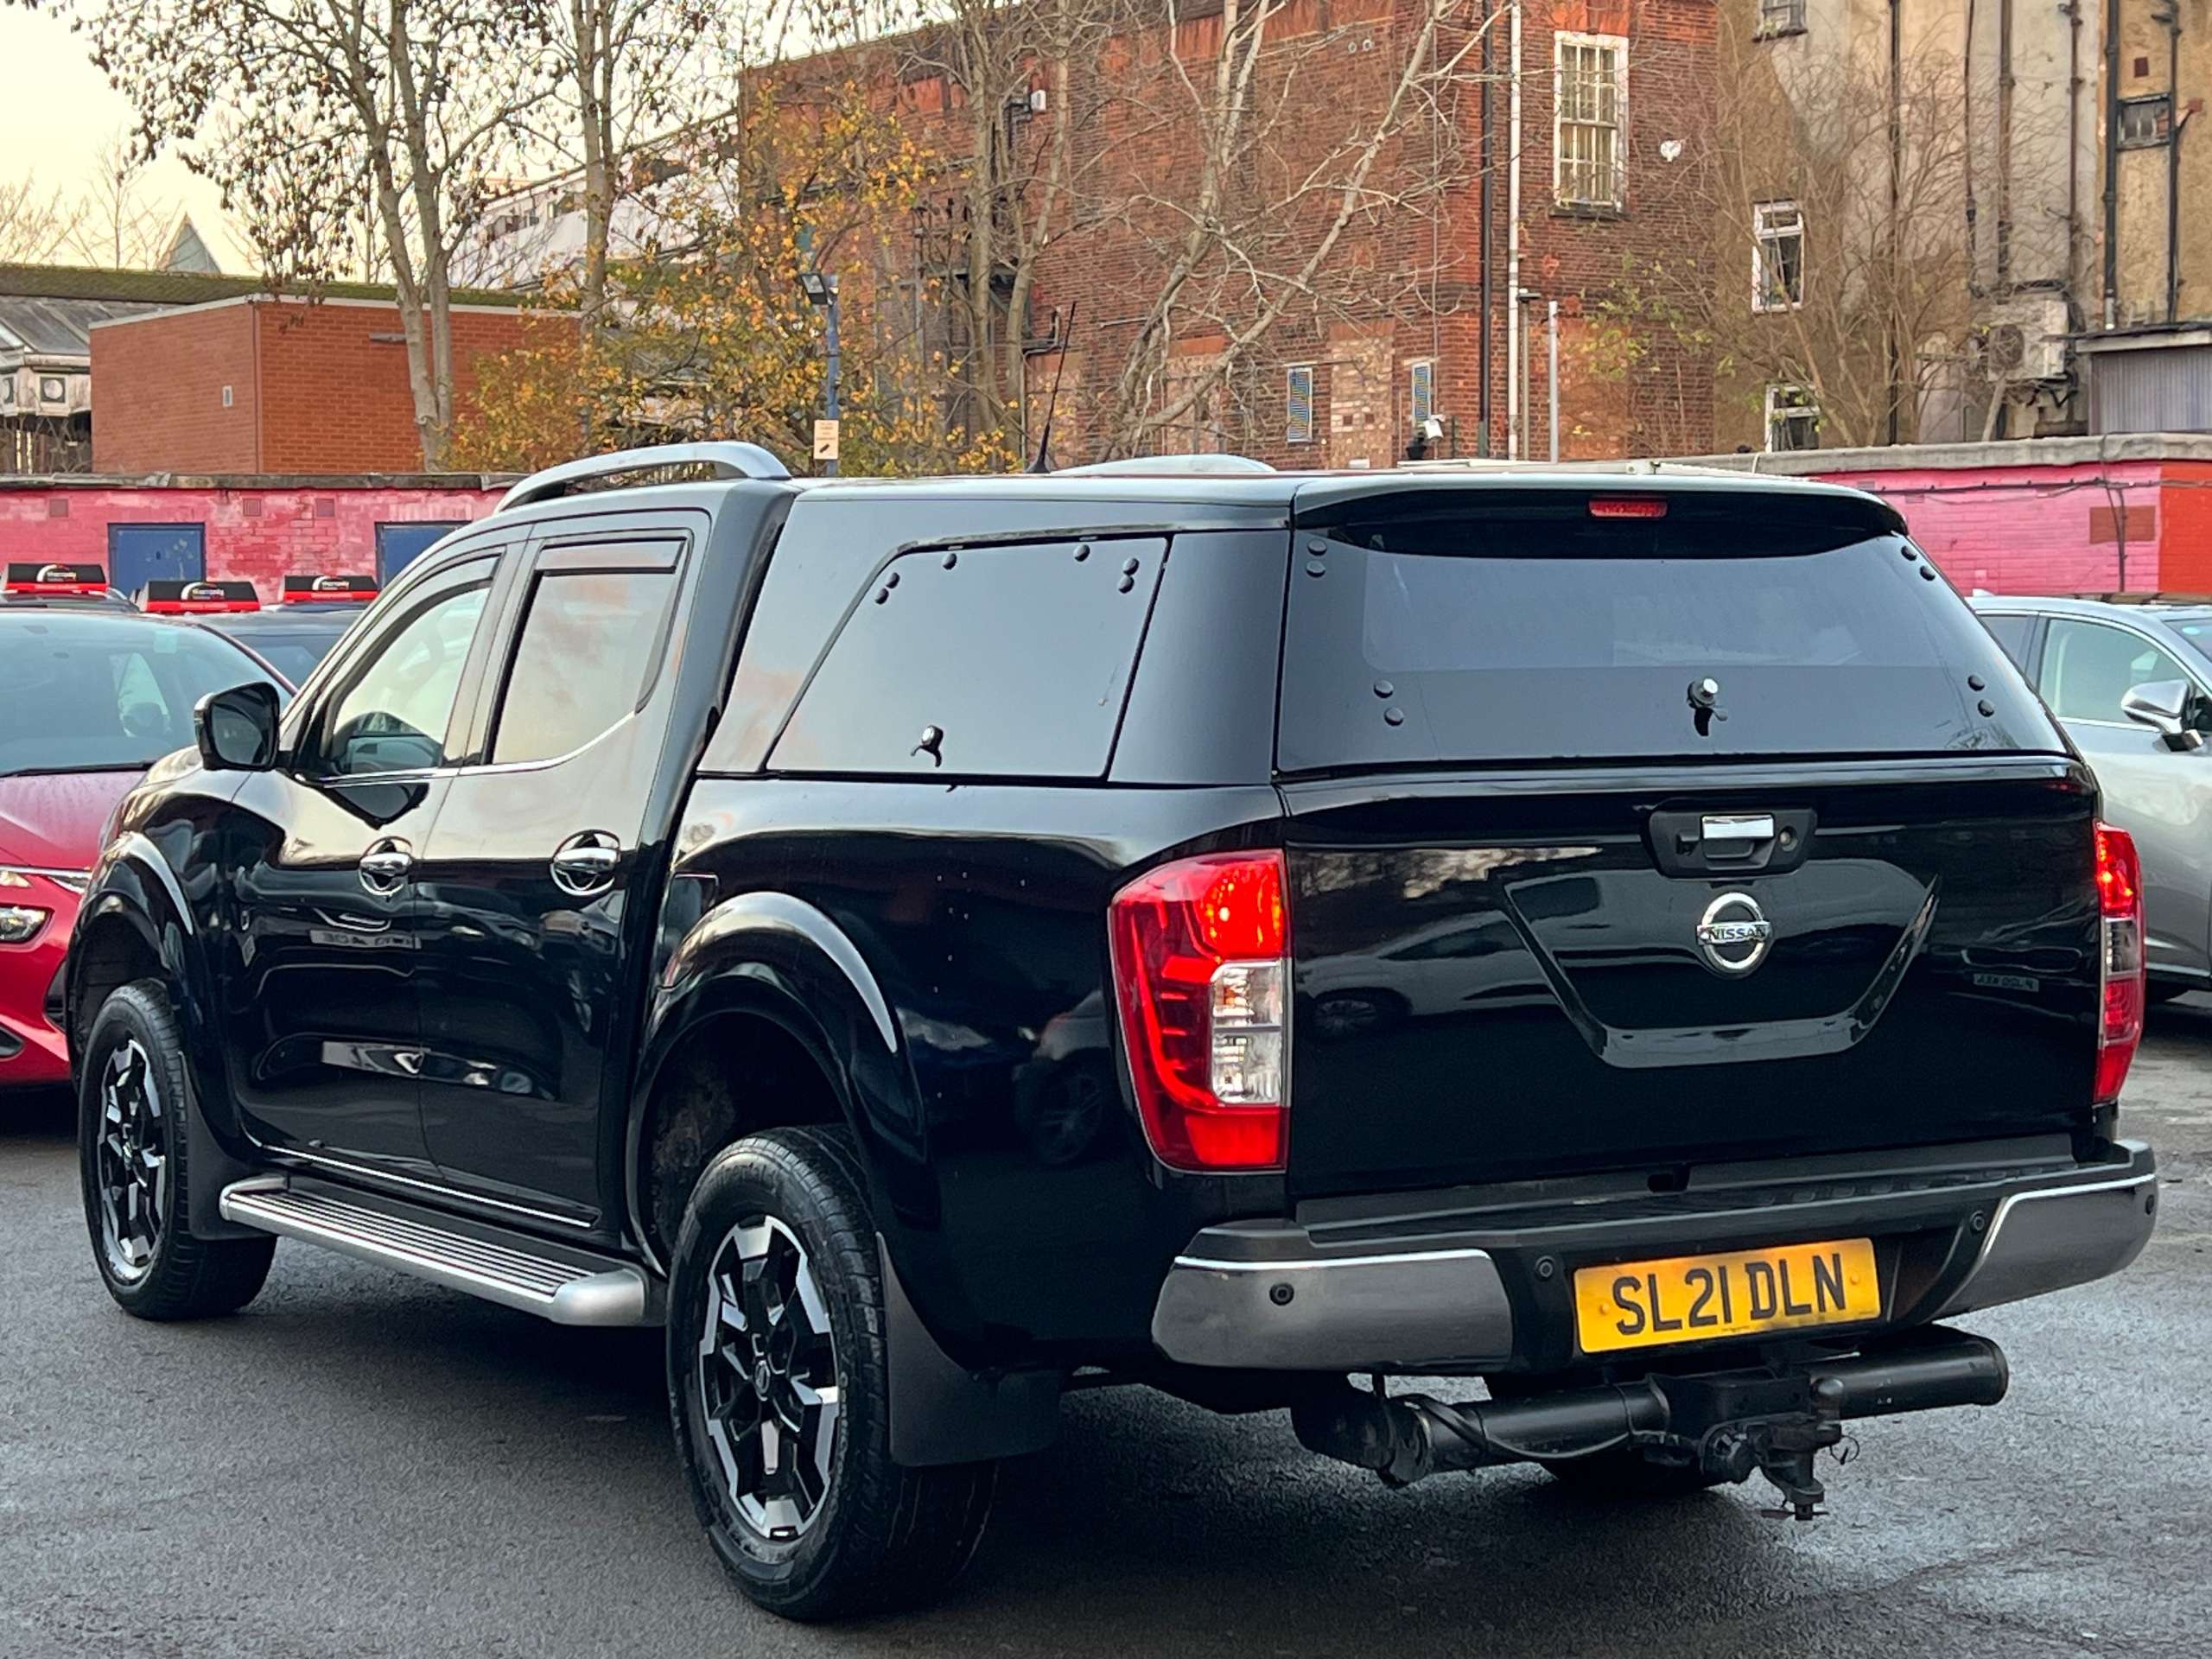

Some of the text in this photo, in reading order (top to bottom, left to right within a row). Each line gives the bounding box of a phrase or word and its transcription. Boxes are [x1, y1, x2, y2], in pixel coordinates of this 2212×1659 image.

[1707, 925, 1766, 940] NISSAN
[1612, 1253, 1847, 1336] SL21 DLN
